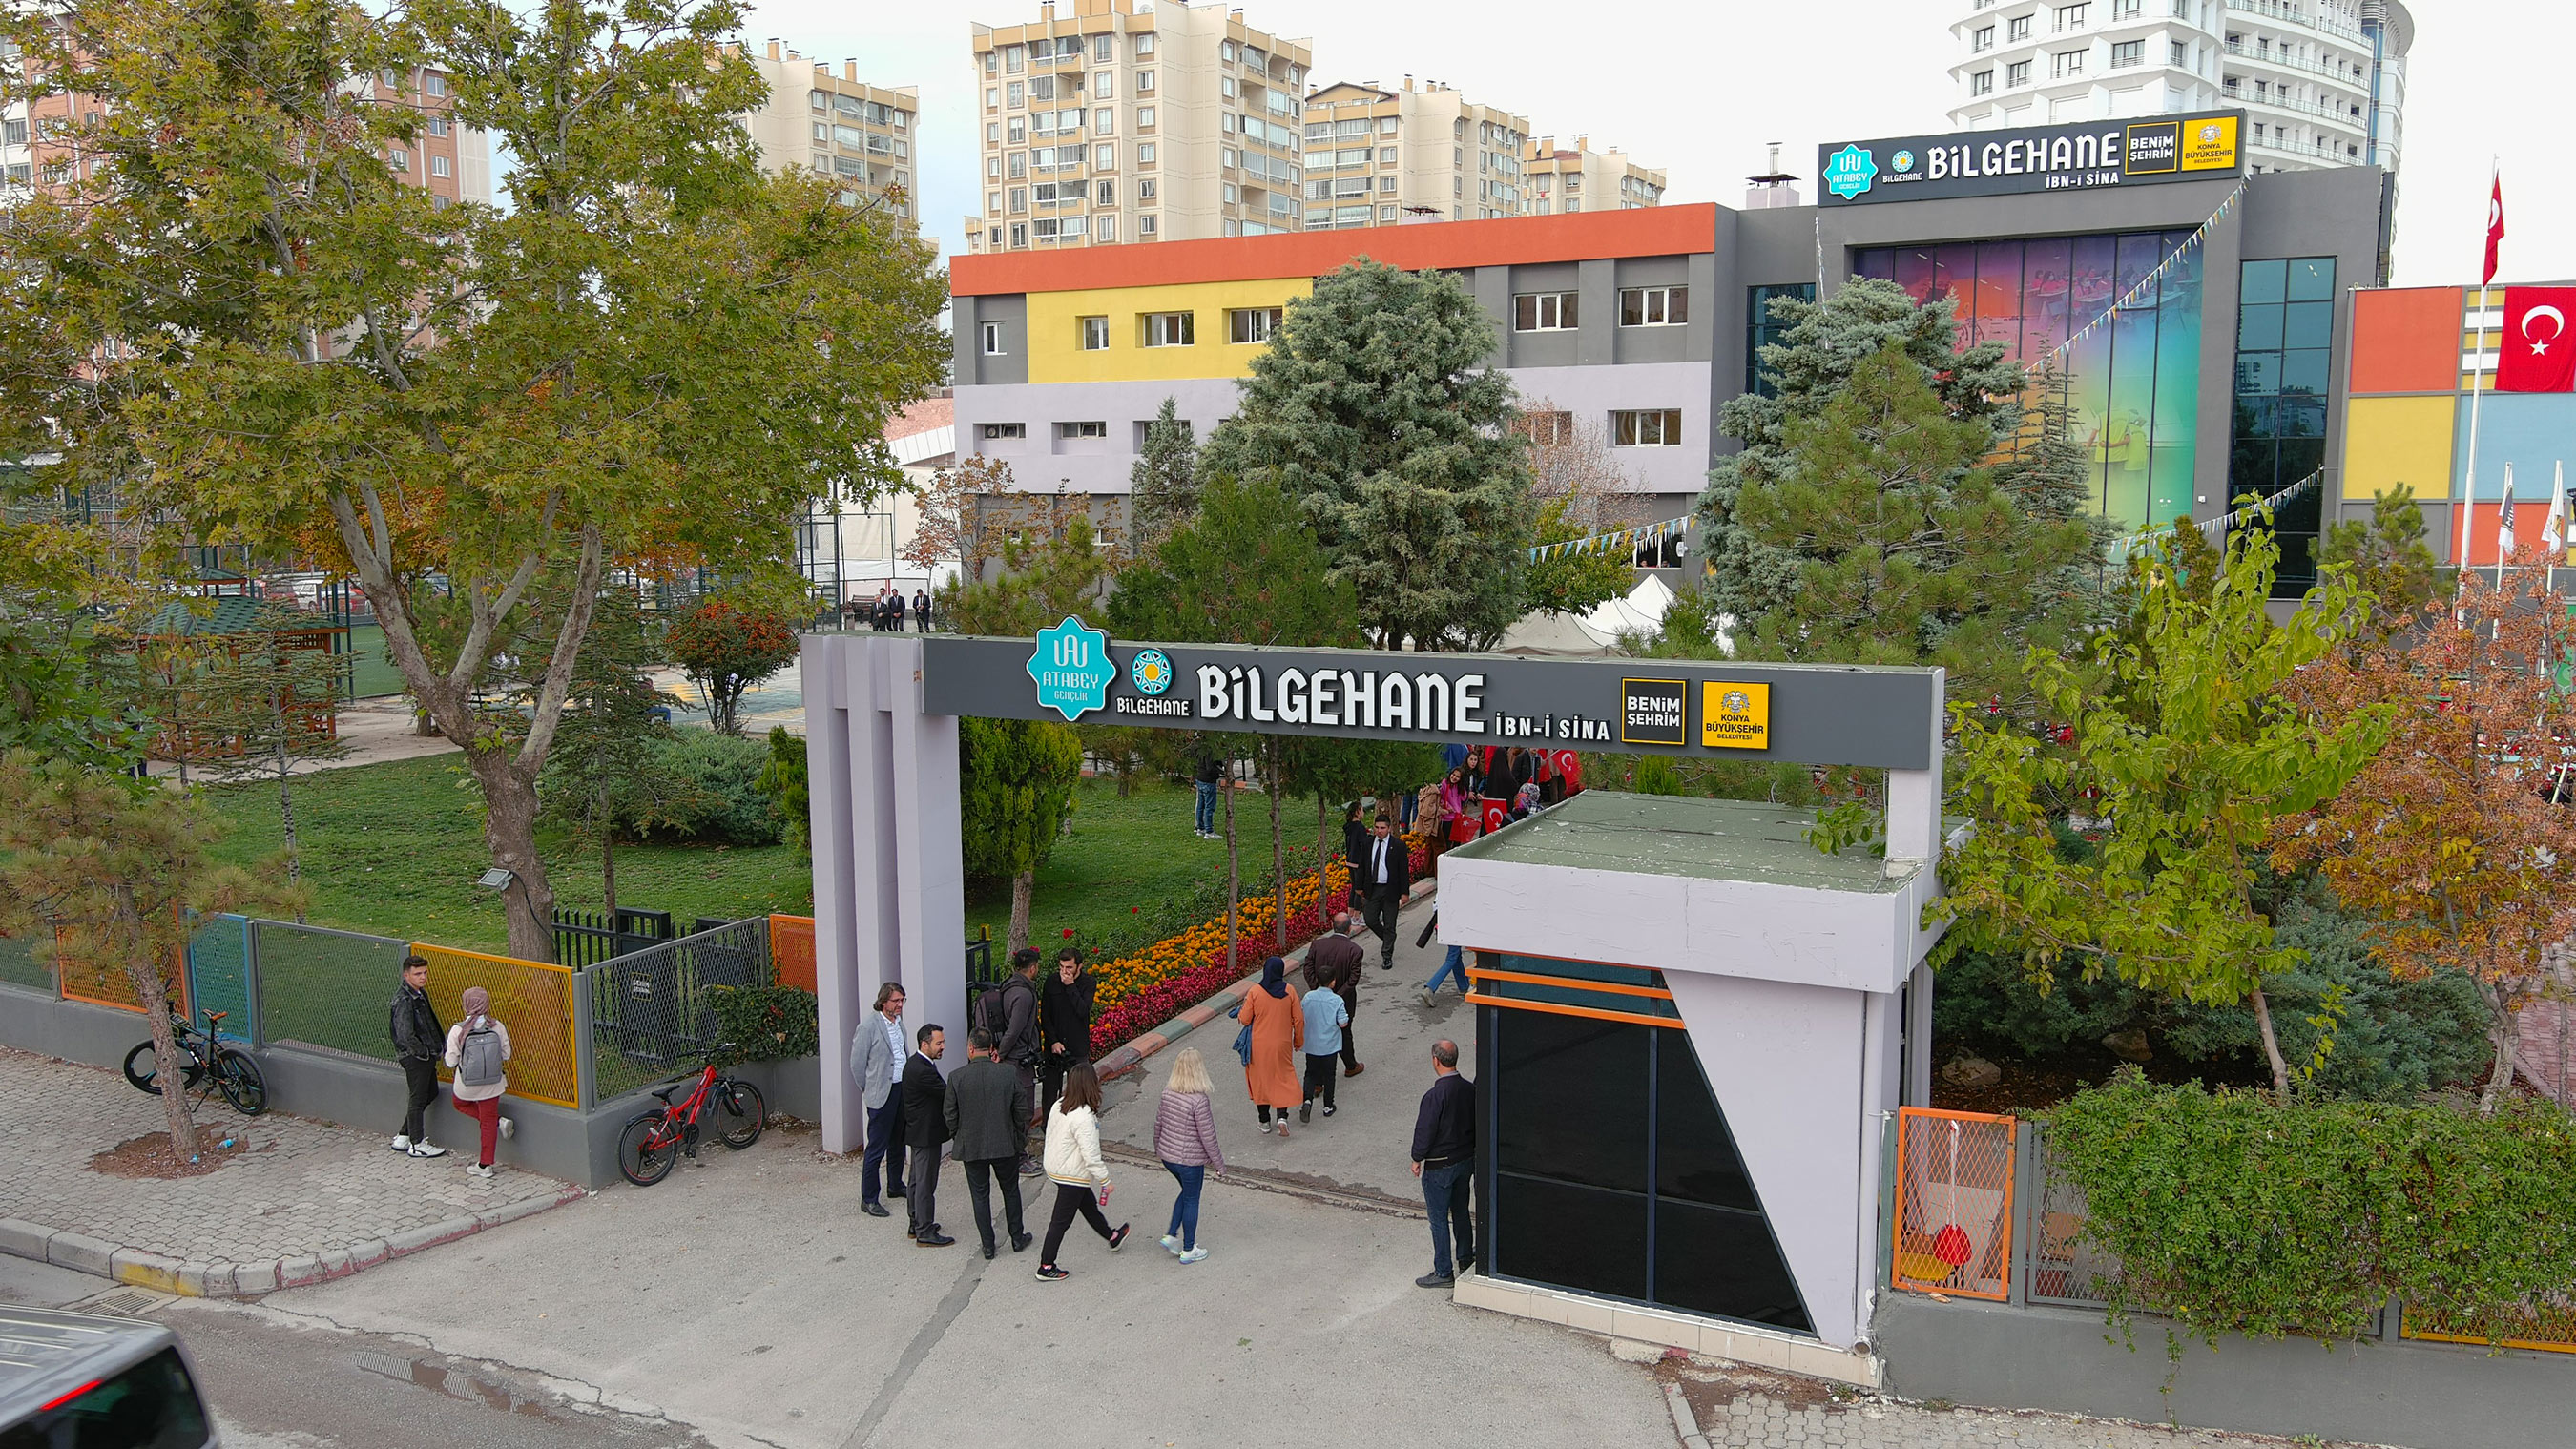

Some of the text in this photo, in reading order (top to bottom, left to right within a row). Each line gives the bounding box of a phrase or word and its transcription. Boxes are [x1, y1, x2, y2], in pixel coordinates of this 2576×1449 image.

[2129, 147, 2173, 161] ŞEHRİM
[2185, 149, 2233, 159] BÜYÜKŞEHİR
[1833, 173, 1867, 183] ATABEY
[2086, 170, 2119, 185] SİNA
[1043, 671, 1099, 689] ATABEY
[1054, 690, 1088, 702] GENÇLİK
[1627, 712, 1680, 727] ŞEHRİM
[1720, 714, 1750, 723] KONYA
[1558, 715, 1610, 740] SİNA
[1706, 721, 1764, 735] BÜYÜKŞEHİR
